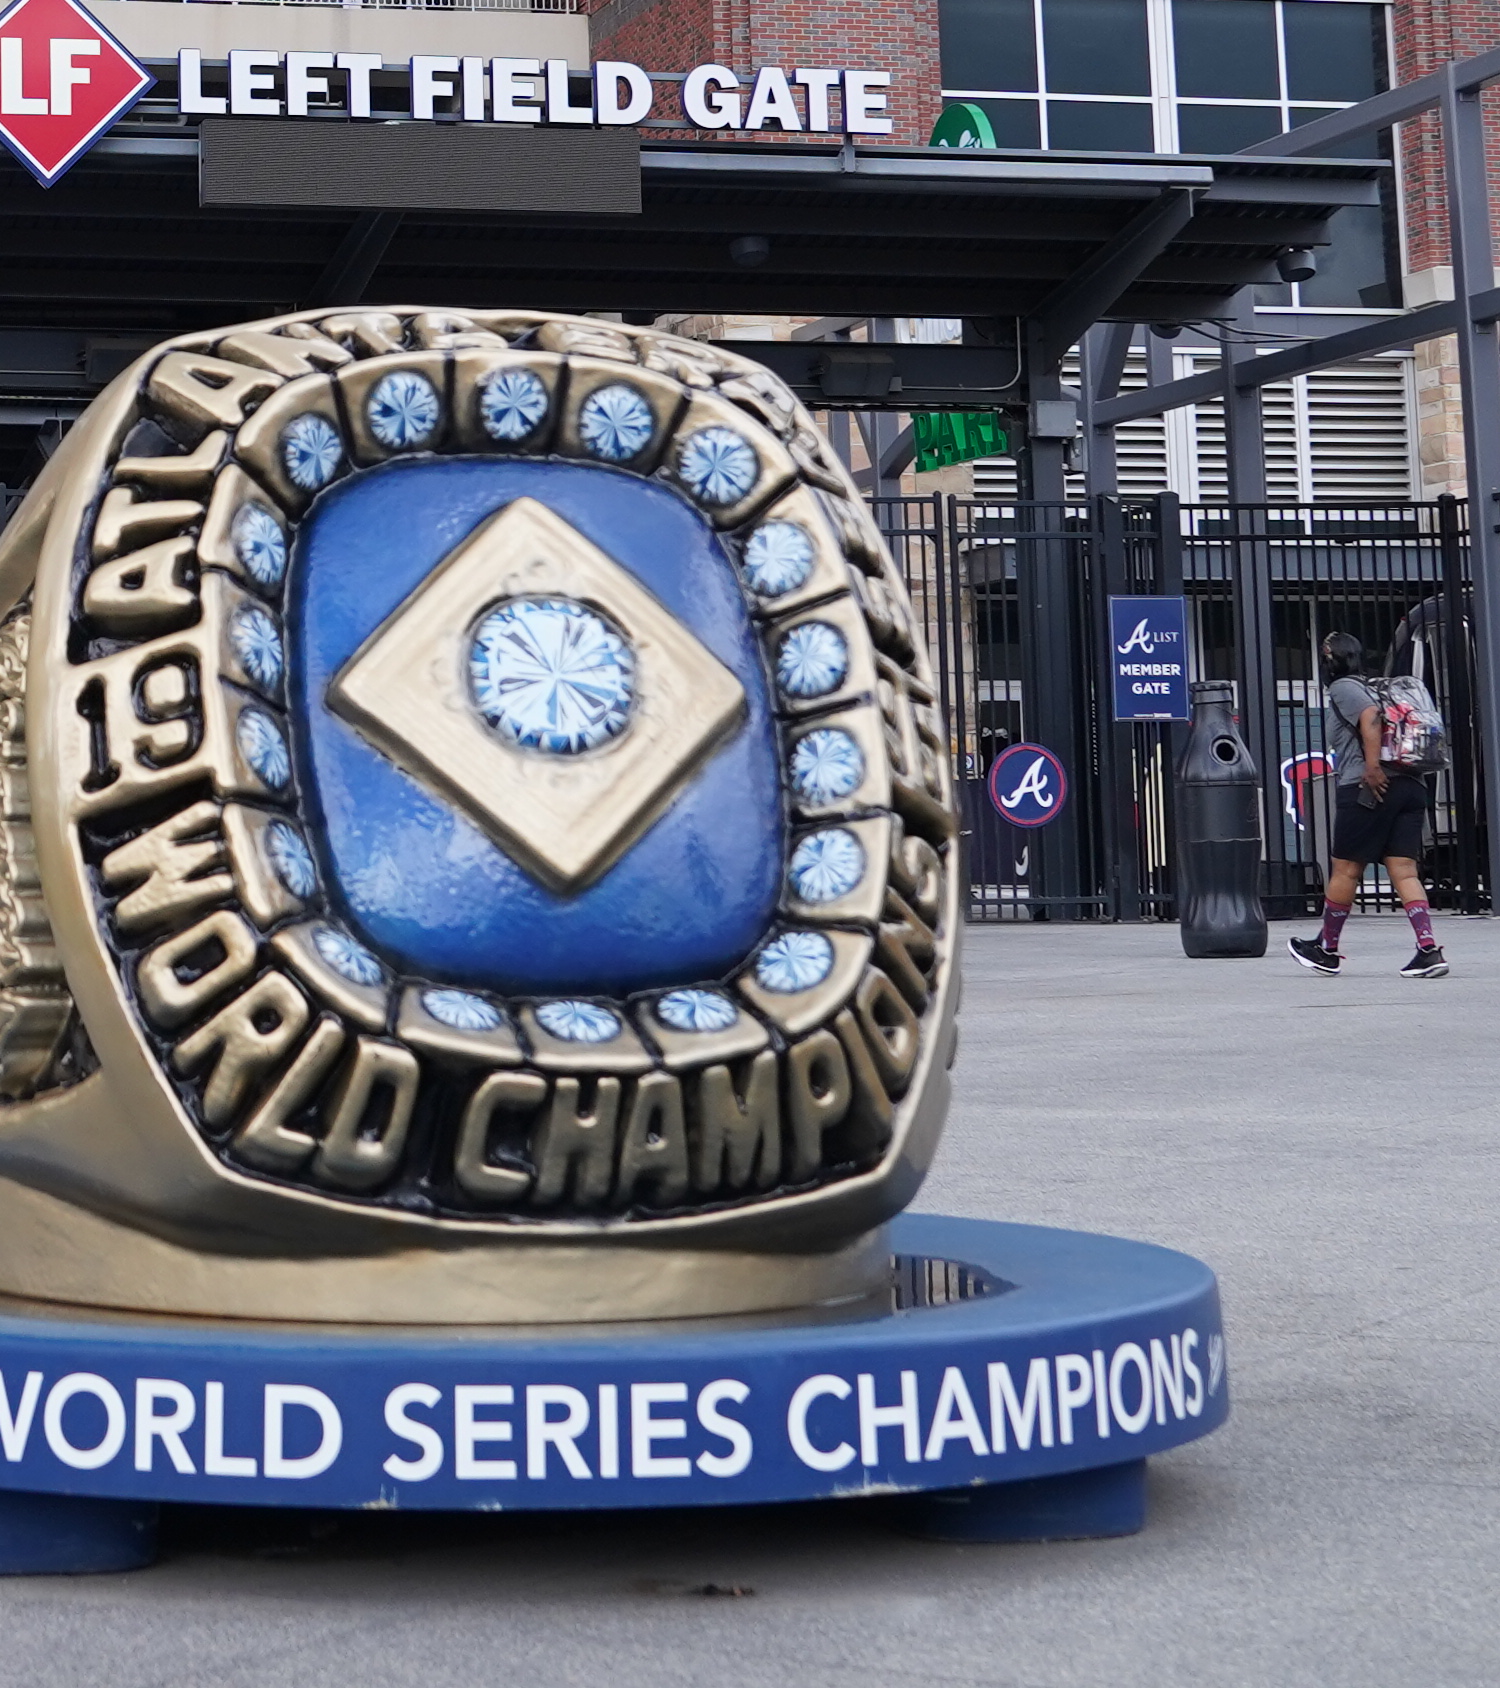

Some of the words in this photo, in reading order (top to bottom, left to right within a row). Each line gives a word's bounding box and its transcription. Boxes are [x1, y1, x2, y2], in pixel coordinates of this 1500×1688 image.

[0, 36, 101, 117] LF
[177, 46, 384, 119] LEFT
[409, 54, 654, 127] FIELD
[682, 63, 894, 136] GATE
[84, 311, 510, 617] ATLANTA
[1120, 663, 1181, 676] MEMBER
[1153, 631, 1180, 643] LIST
[75, 646, 202, 793] 19
[1132, 682, 1171, 695] GATE
[102, 802, 420, 1188] WORLD
[457, 835, 945, 1206] CHAMPIONS
[381, 1378, 754, 1484] SERIES
[786, 1327, 1205, 1472] CHAMPIONS
